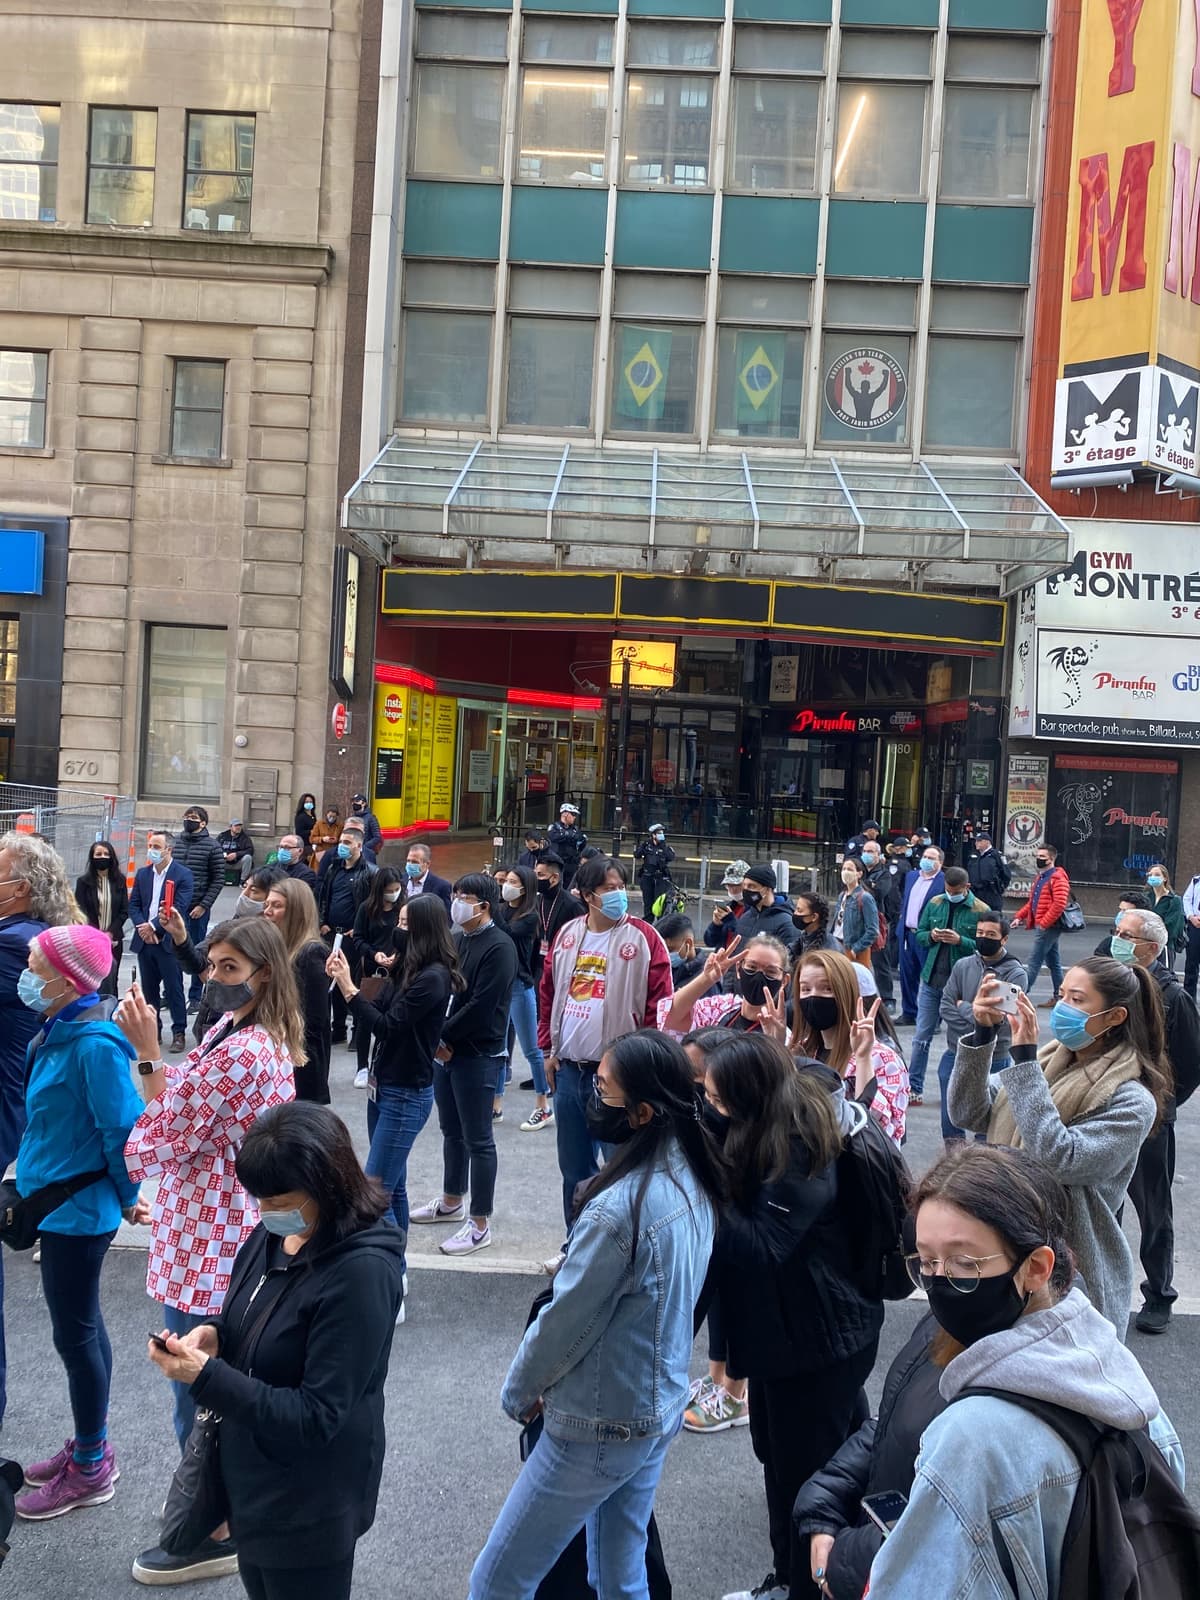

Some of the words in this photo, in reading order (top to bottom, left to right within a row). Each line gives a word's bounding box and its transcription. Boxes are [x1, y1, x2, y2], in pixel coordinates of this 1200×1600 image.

[1086, 446, 1137, 461] étage
[1167, 449, 1194, 469] étage
[1090, 551, 1133, 570] GYM
[1092, 672, 1156, 692] Piranha
[1132, 690, 1154, 700] BAR
[792, 710, 856, 732] Piranha
[858, 718, 881, 731] BAR
[1040, 719, 1056, 732] Bar
[64, 760, 99, 777] 670
[1102, 807, 1169, 828] Piranha
[1143, 825, 1166, 837] BAR
